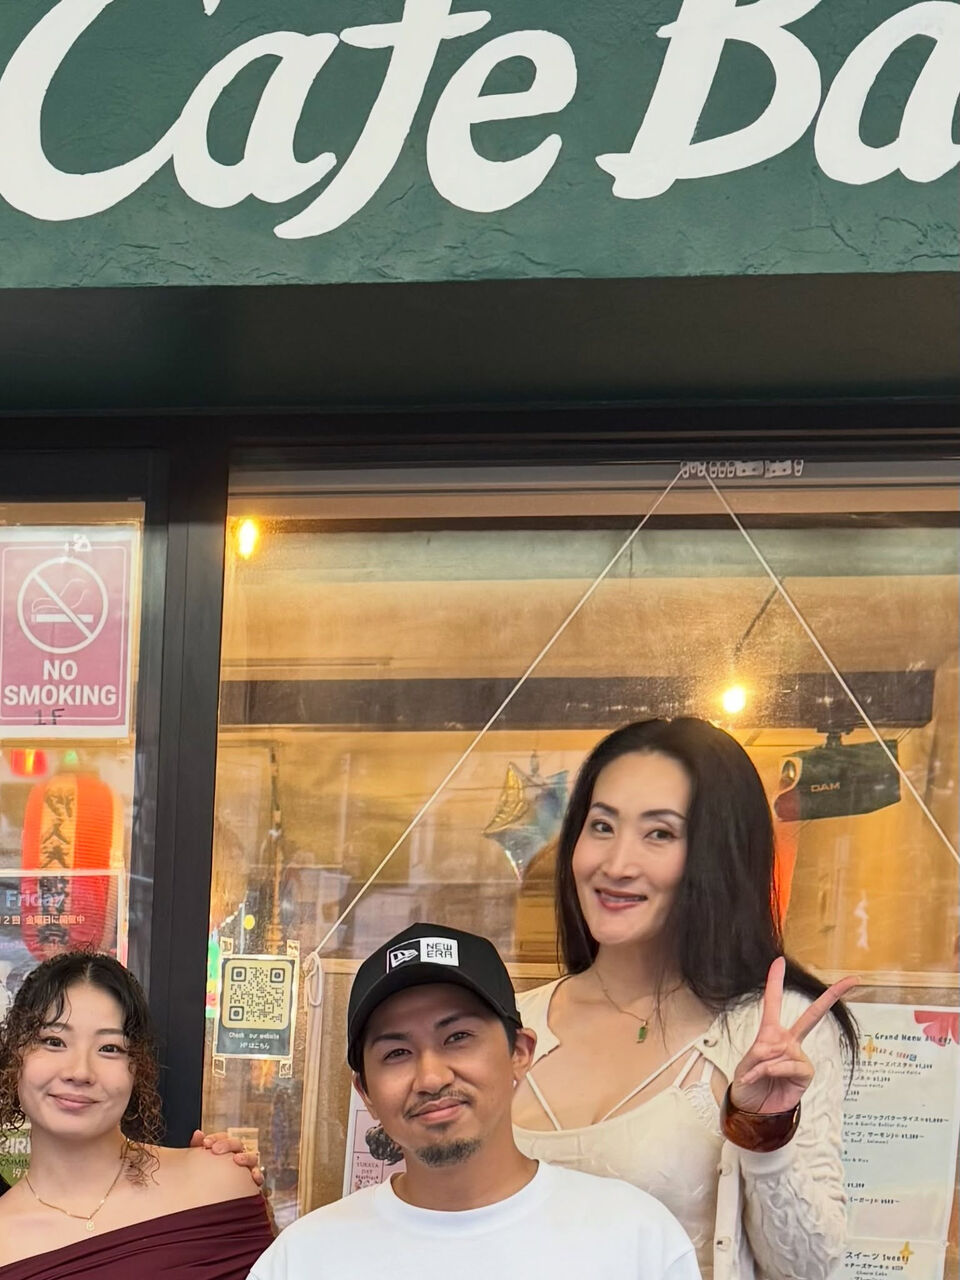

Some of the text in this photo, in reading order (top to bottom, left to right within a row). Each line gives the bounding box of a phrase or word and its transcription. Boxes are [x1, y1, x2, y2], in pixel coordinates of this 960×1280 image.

[42, 660, 78, 680] NO
[3, 685, 118, 706] SMOKING
[810, 783, 841, 793] DAM
[5, 890, 66, 908] Friday
[426, 943, 453, 951] NEW
[426, 951, 453, 959] ERA
[845, 1251, 880, 1261] スイーツ
